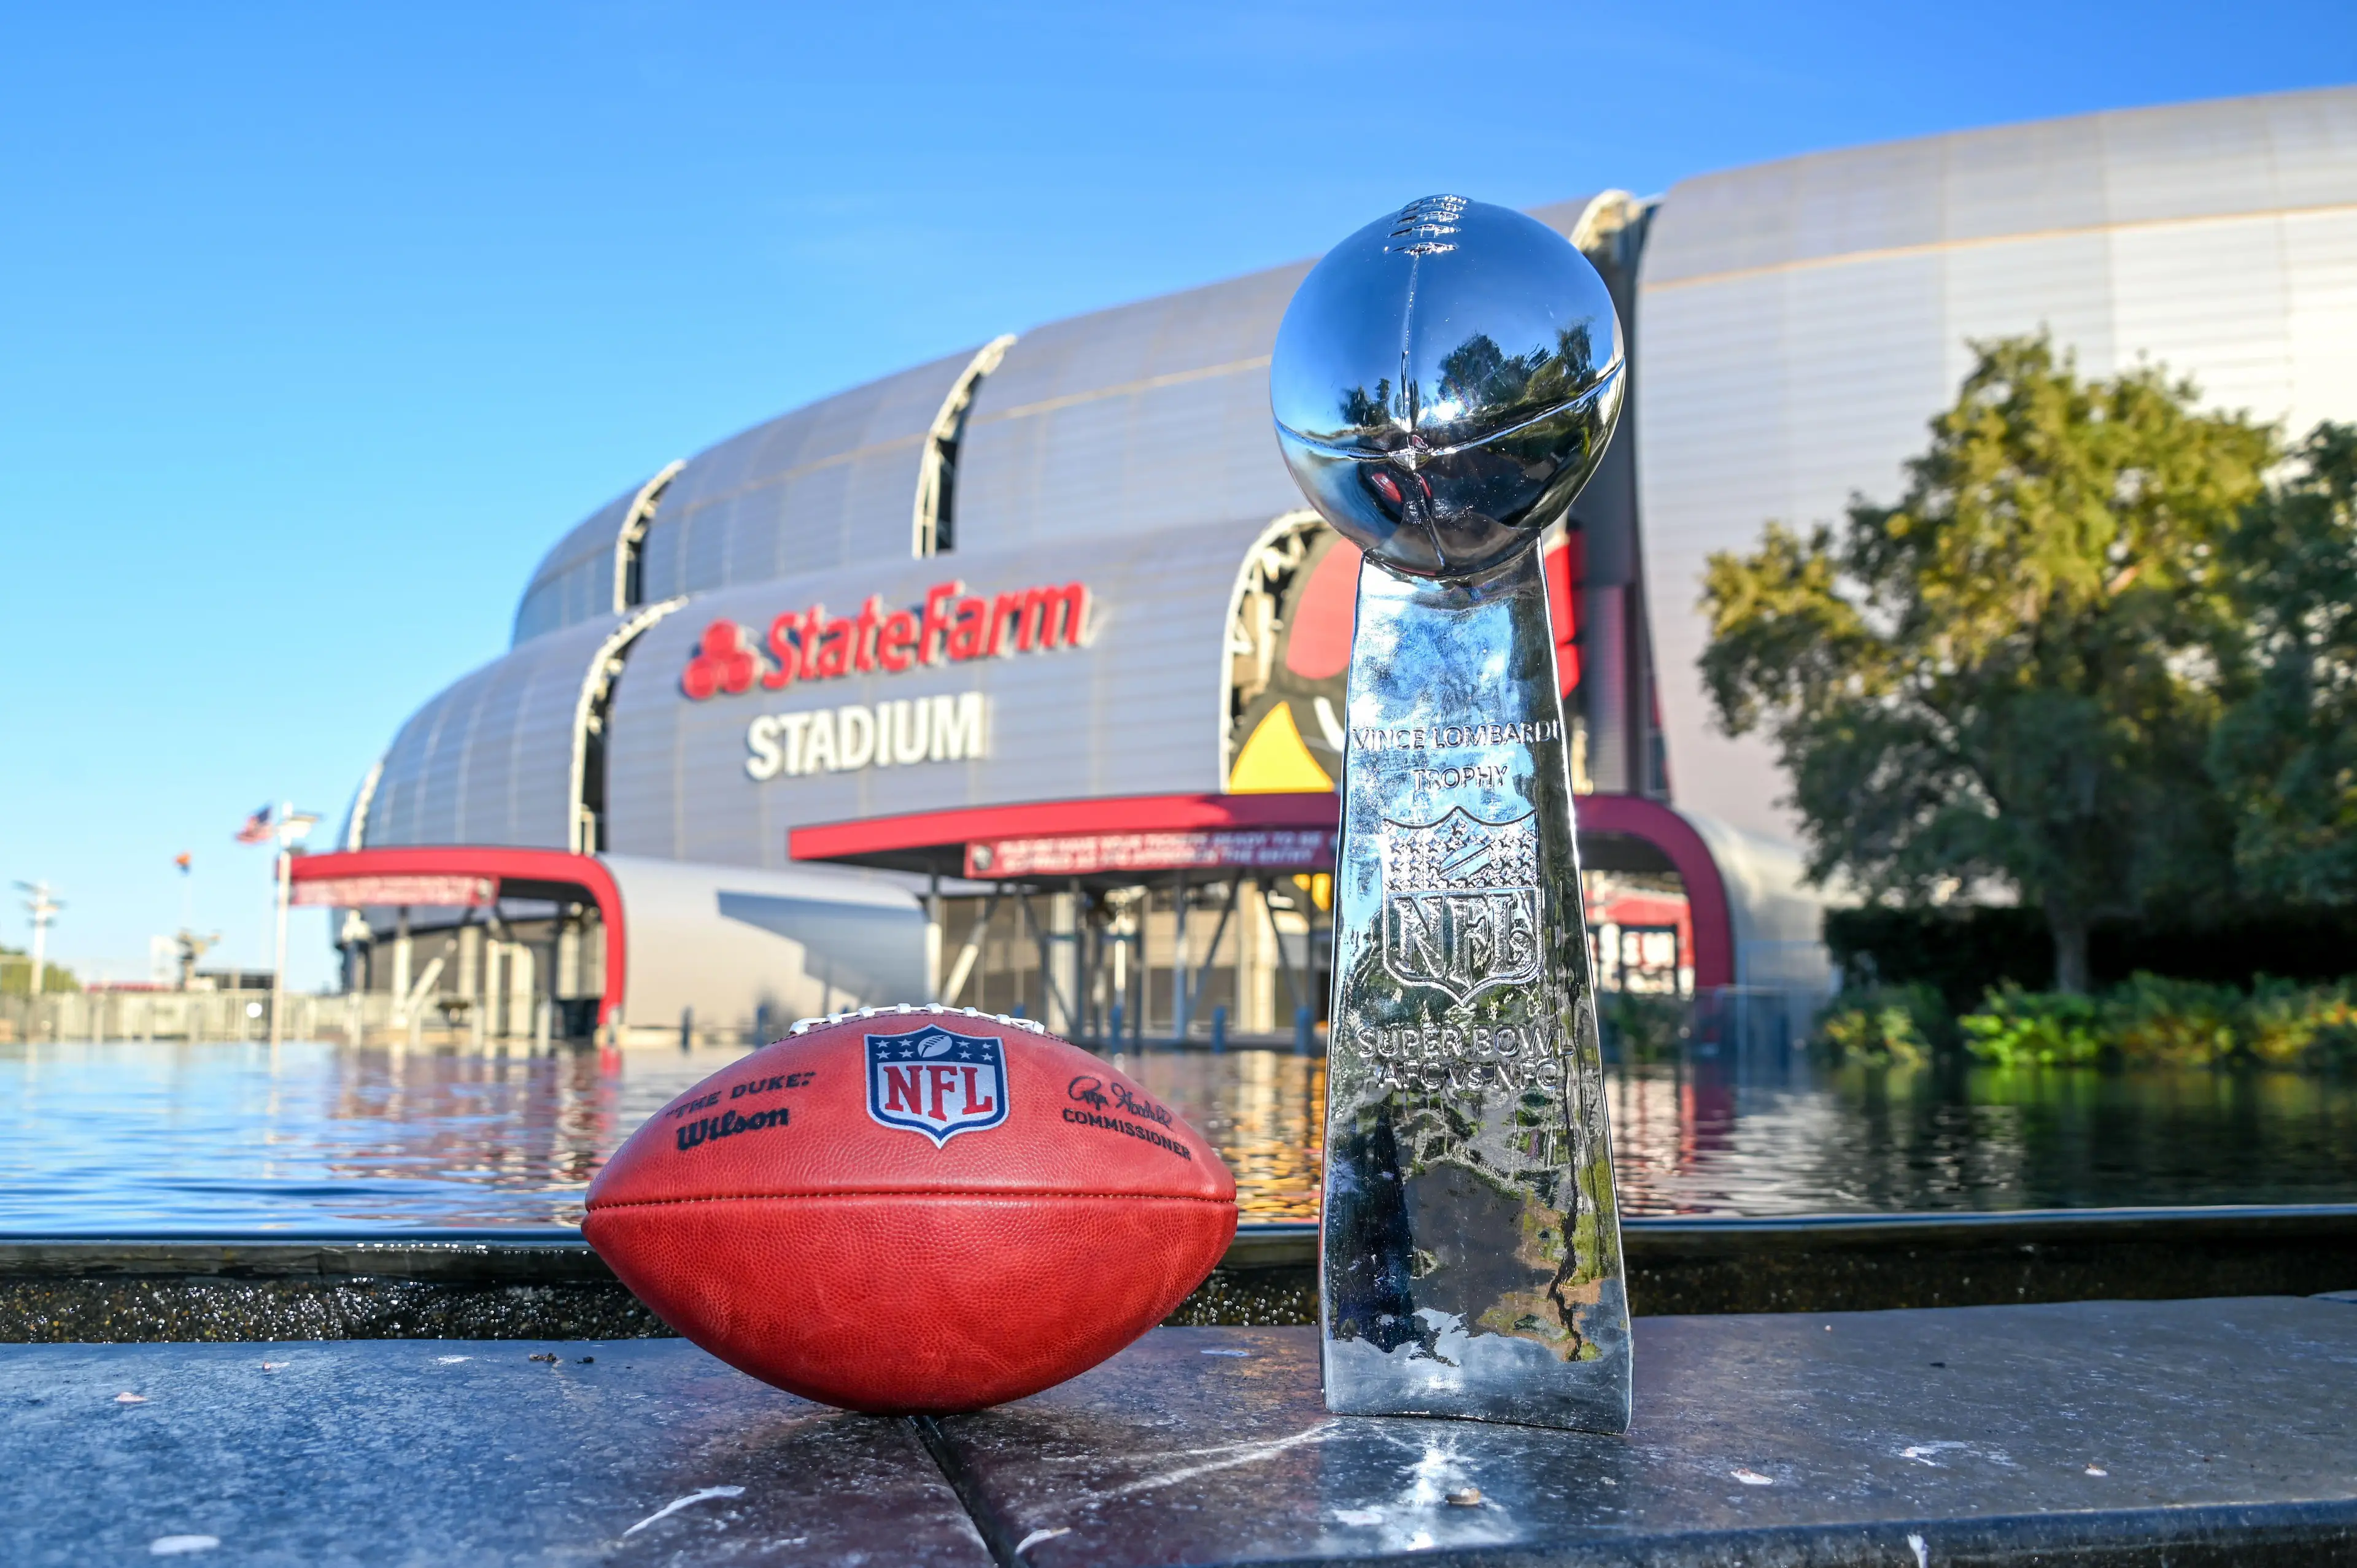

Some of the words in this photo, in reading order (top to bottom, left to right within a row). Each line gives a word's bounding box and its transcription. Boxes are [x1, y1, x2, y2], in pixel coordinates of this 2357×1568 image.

[745, 692, 987, 781] STADIUM
[1352, 727, 1425, 751] VINCE
[1432, 719, 1560, 749] LOMBARDI
[1414, 765, 1507, 790] TROPHY
[1392, 892, 1536, 987] NFL
[1357, 1023, 1463, 1058] SUPER
[1473, 1024, 1574, 1057] BOWL
[883, 1065, 993, 1122] NFL
[1379, 1059, 1442, 1091] AFC
[1492, 1059, 1560, 1091] NFC
[676, 1107, 789, 1151] Wilson
[1062, 1107, 1191, 1161] COMMISSIONER
